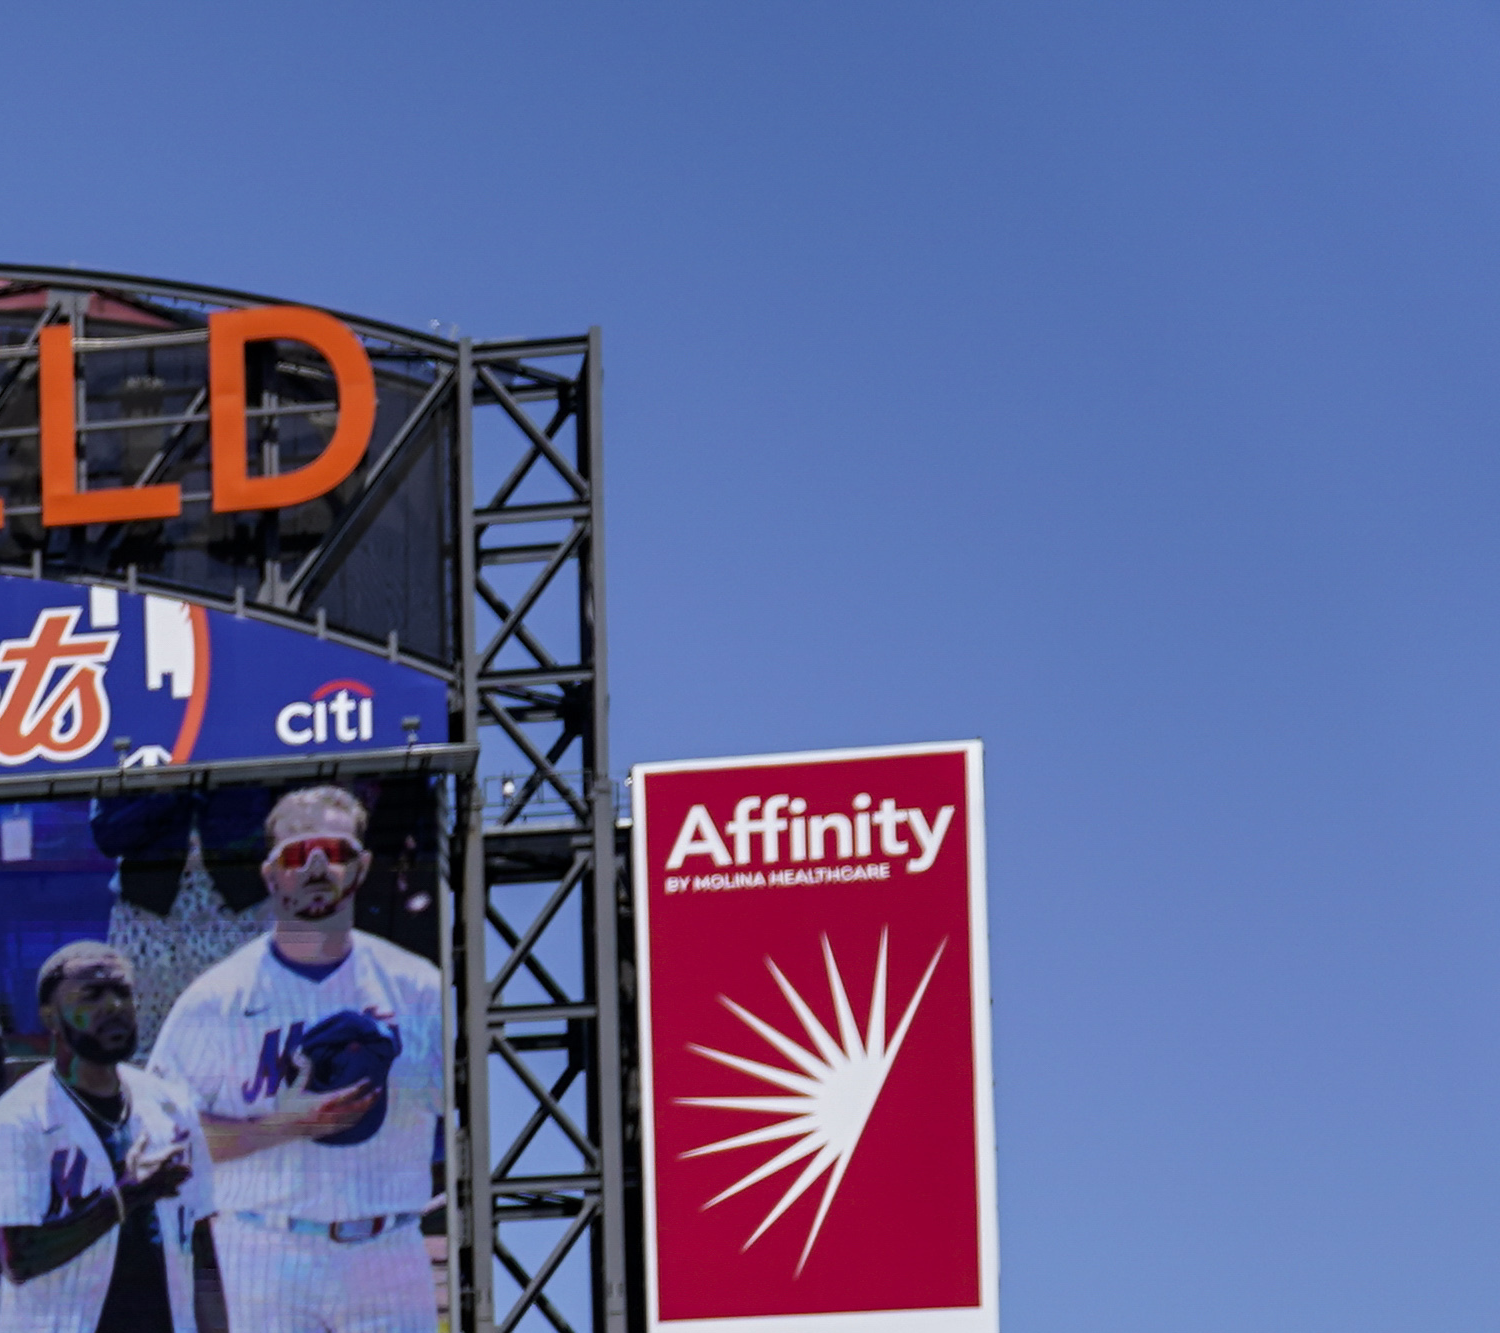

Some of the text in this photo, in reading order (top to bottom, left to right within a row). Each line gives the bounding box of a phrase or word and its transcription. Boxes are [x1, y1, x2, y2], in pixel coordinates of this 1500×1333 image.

[275, 690, 375, 746] citi
[664, 792, 956, 873] Affinity
[665, 862, 891, 894] BY MOLINA HEALTHCARE
